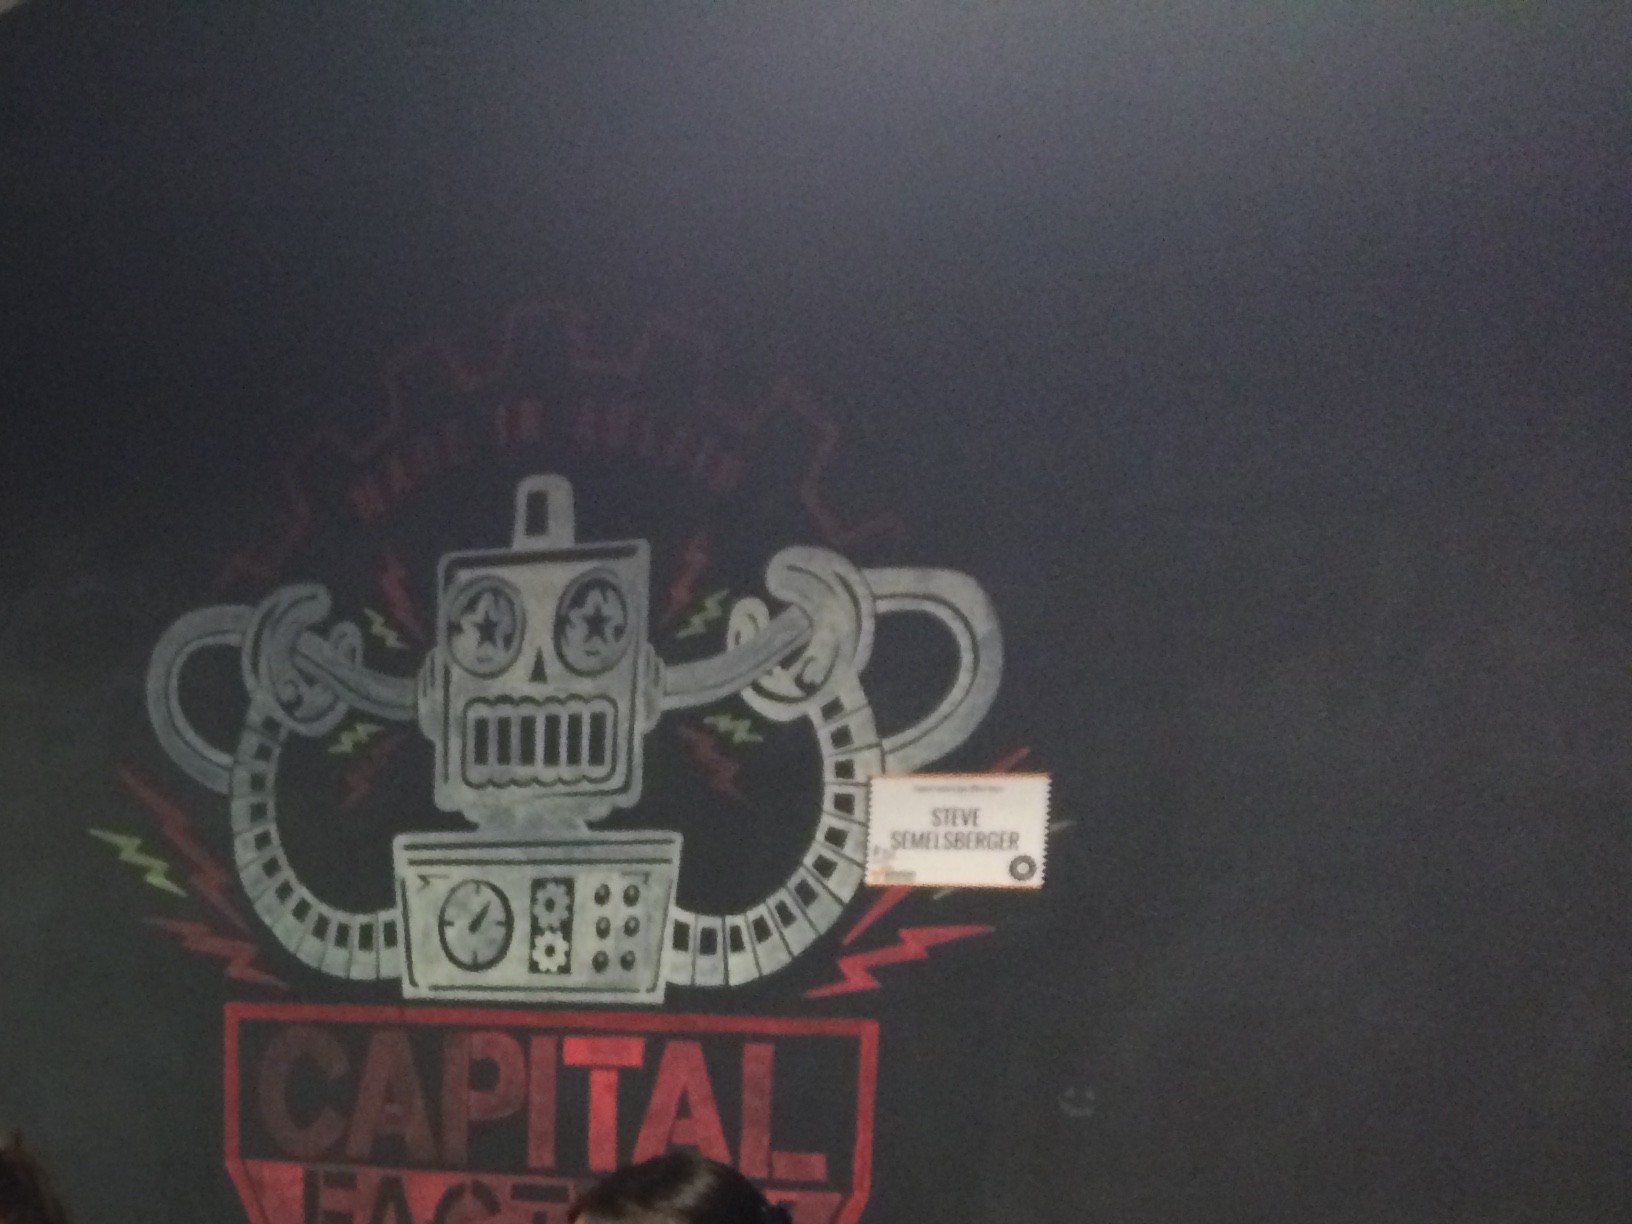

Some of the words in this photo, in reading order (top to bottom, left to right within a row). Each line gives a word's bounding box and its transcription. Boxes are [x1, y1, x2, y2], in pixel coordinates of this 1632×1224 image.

[931, 807, 980, 827] STEVE
[890, 831, 1020, 850] SEMELSBERGER
[259, 1025, 828, 1181] CAPITAL
